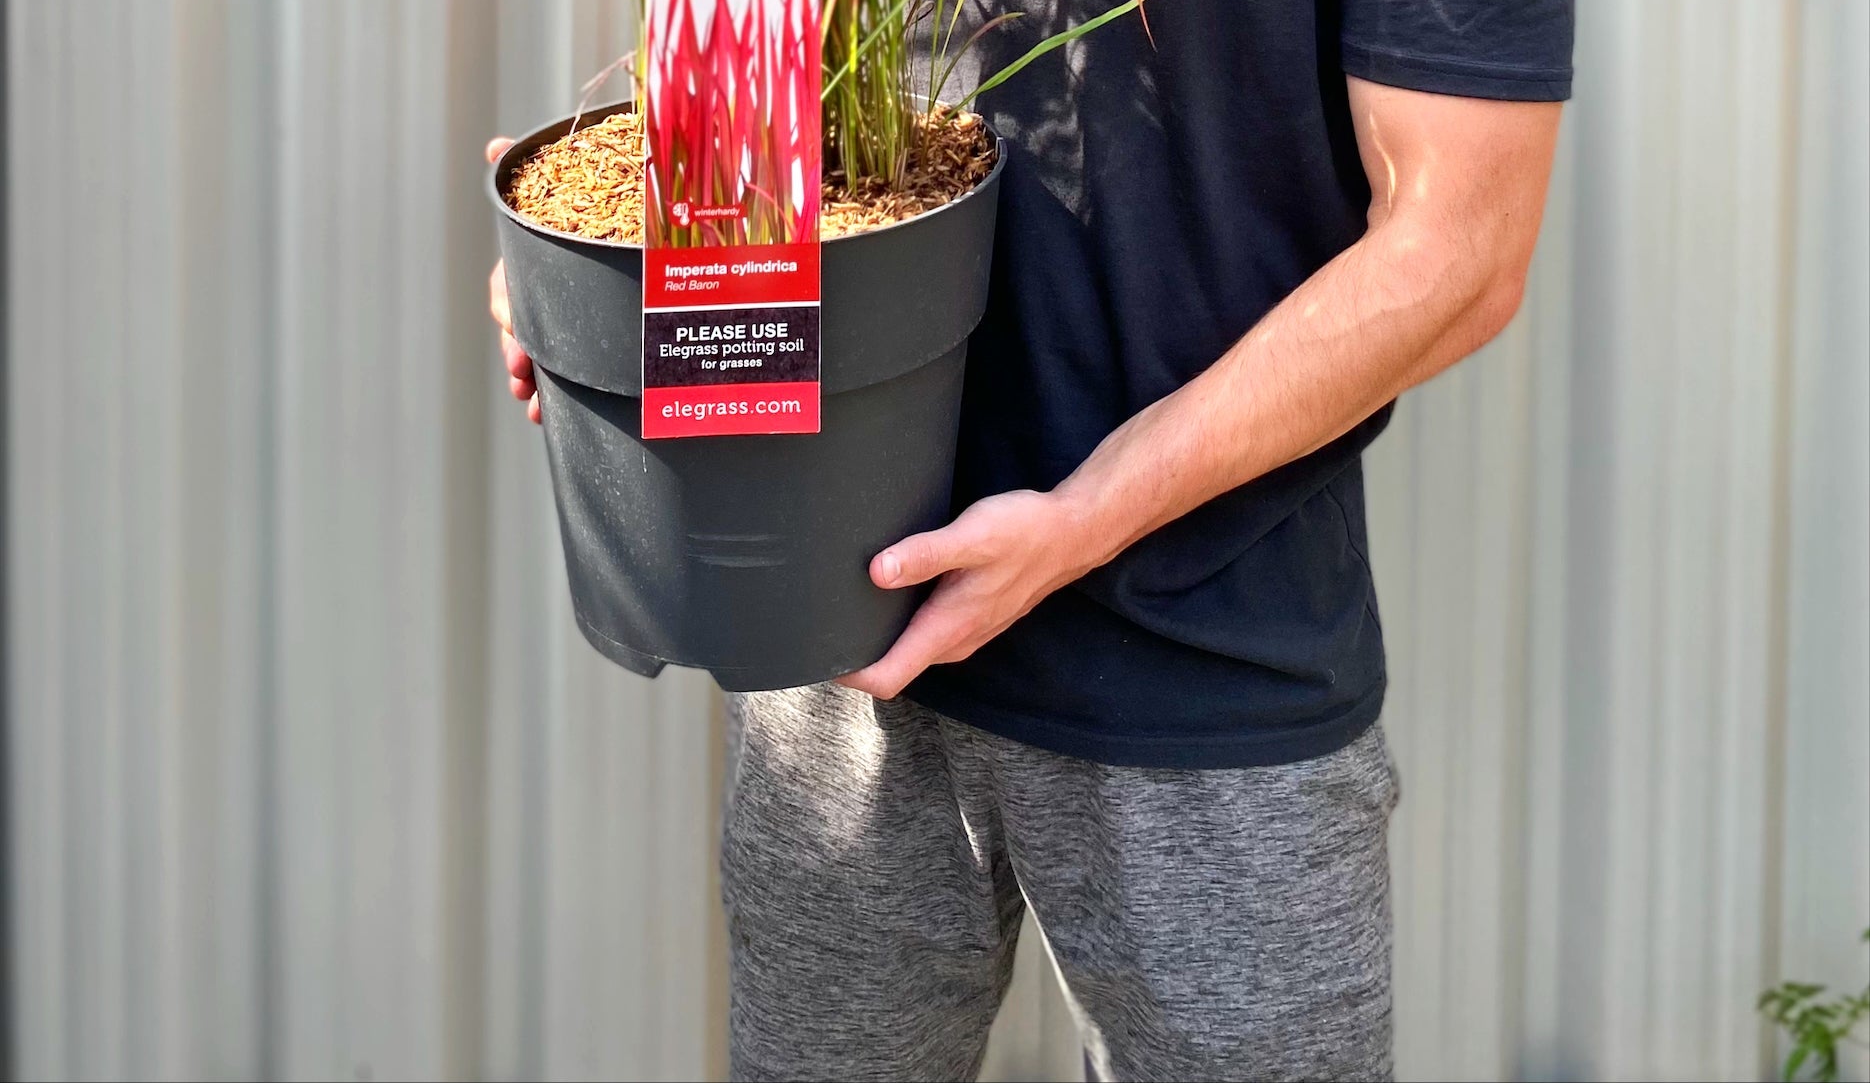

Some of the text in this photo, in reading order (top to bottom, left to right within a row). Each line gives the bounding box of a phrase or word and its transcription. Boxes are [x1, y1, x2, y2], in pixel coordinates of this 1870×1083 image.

[694, 207, 741, 217] winterhardy
[665, 260, 798, 279] Imperata cylindrica
[665, 280, 720, 292] Red Baron
[676, 323, 788, 342] PLEASE USE
[659, 338, 804, 360] Elegrass potting soil
[701, 358, 763, 371] for grasses
[662, 399, 801, 420] elegrass.com
